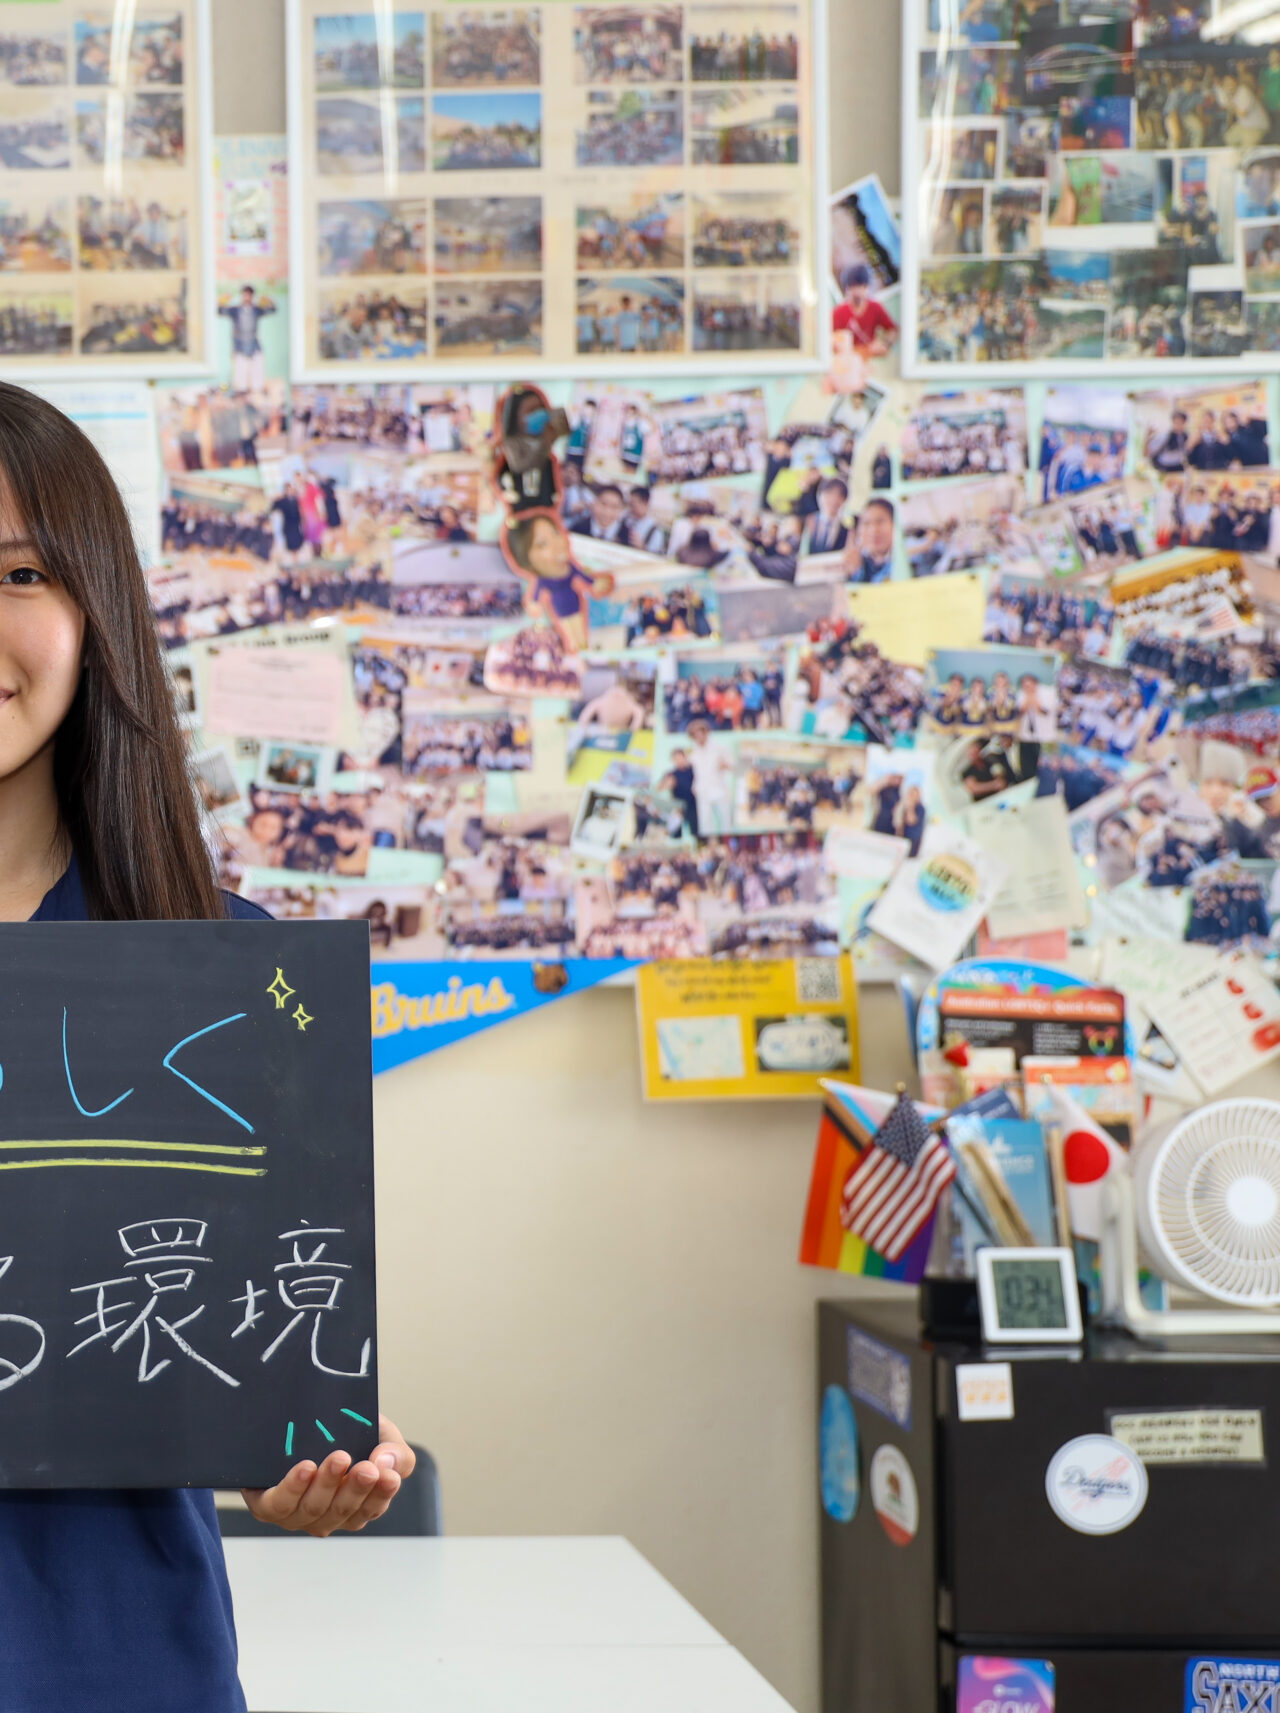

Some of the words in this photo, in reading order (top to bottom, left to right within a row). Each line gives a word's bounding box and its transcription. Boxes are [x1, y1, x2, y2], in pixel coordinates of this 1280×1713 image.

[370, 975, 518, 1038] Bruins
[1192, 1661, 1280, 1713] SAX
[1220, 1663, 1280, 1680] NORTH
